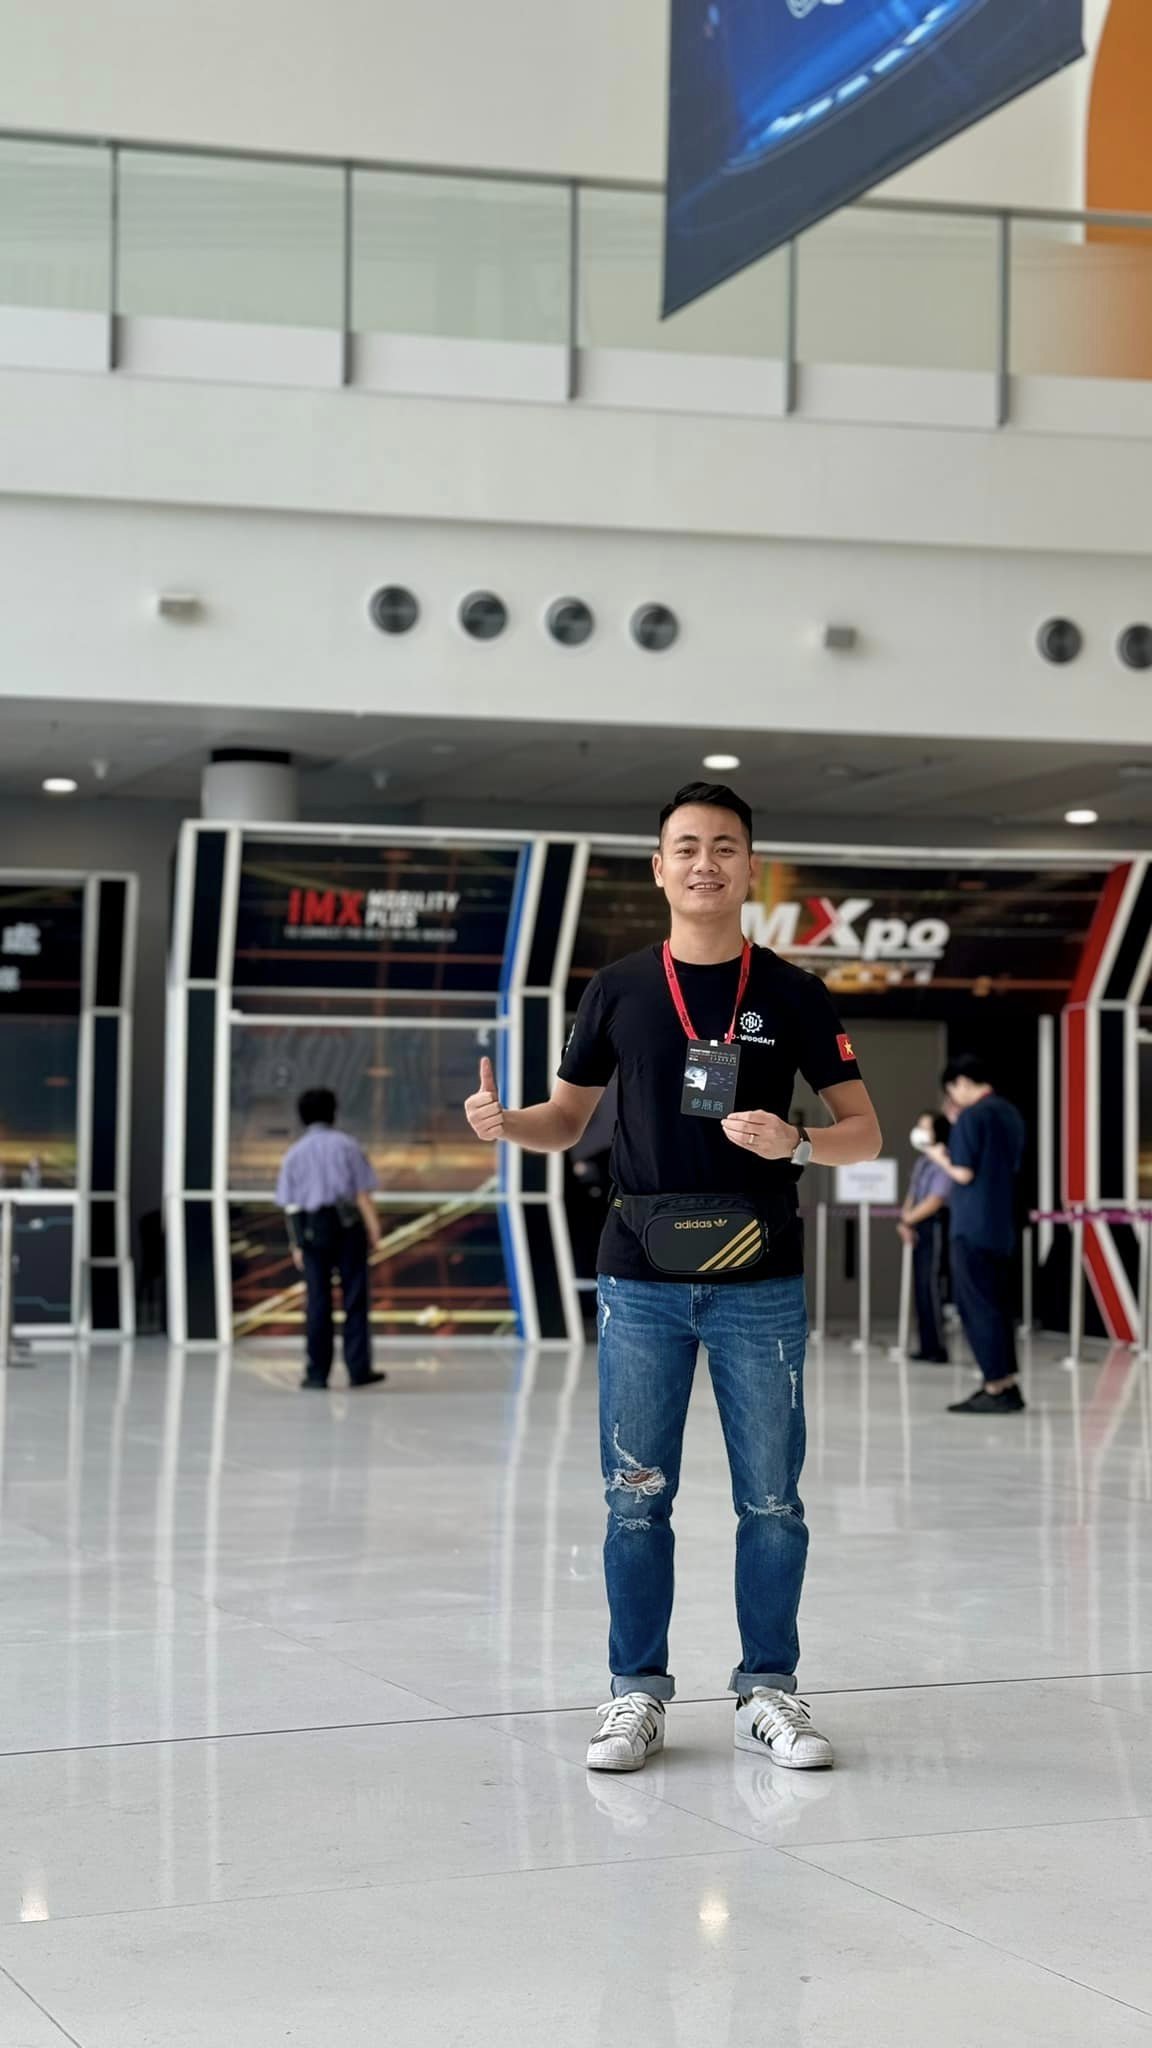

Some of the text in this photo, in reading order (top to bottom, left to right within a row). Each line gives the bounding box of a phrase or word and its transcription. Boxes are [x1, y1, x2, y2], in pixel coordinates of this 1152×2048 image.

[288, 889, 364, 927] IMX
[367, 890, 459, 911] MOBILITY
[365, 910, 417, 928] PLUS
[673, 1218, 713, 1230] adidas
